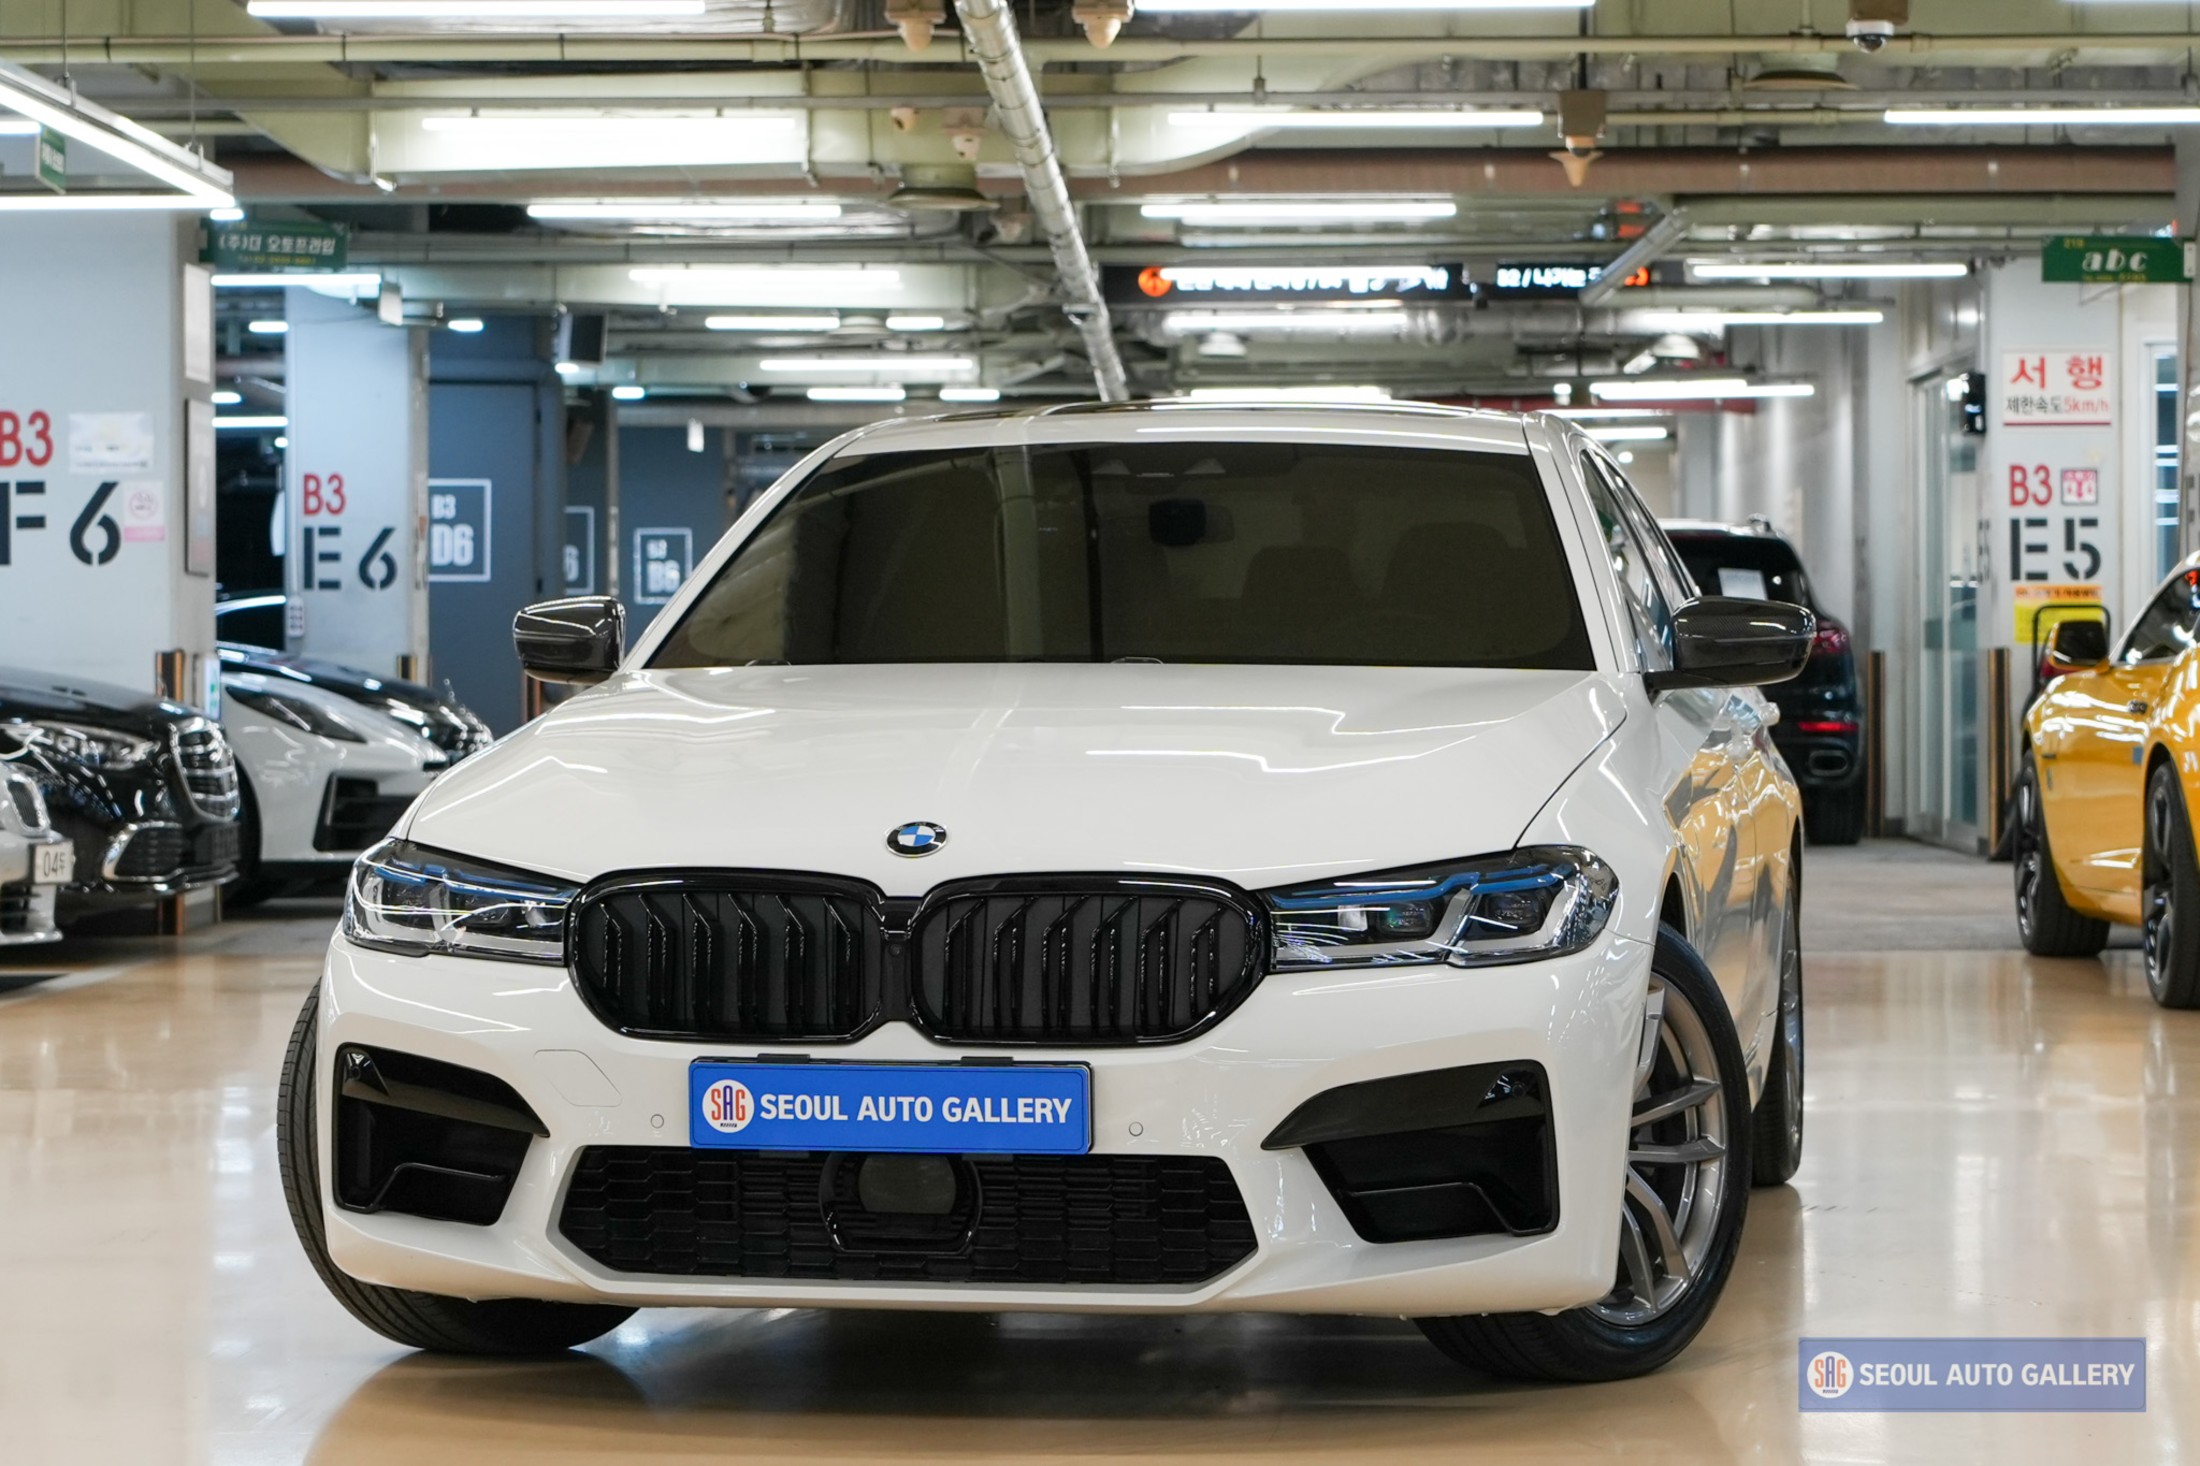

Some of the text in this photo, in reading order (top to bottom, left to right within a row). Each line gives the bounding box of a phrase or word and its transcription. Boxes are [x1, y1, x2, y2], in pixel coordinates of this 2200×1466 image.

[2082, 249, 2147, 272] abc
[0, 409, 53, 467] B3
[303, 473, 346, 516] B3
[2009, 465, 2052, 507] B3
[431, 494, 456, 519] B3
[431, 523, 474, 566] D6
[711, 1085, 746, 1121] SAG
[760, 1094, 1072, 1124] SEOUL AUTO GALLERY
